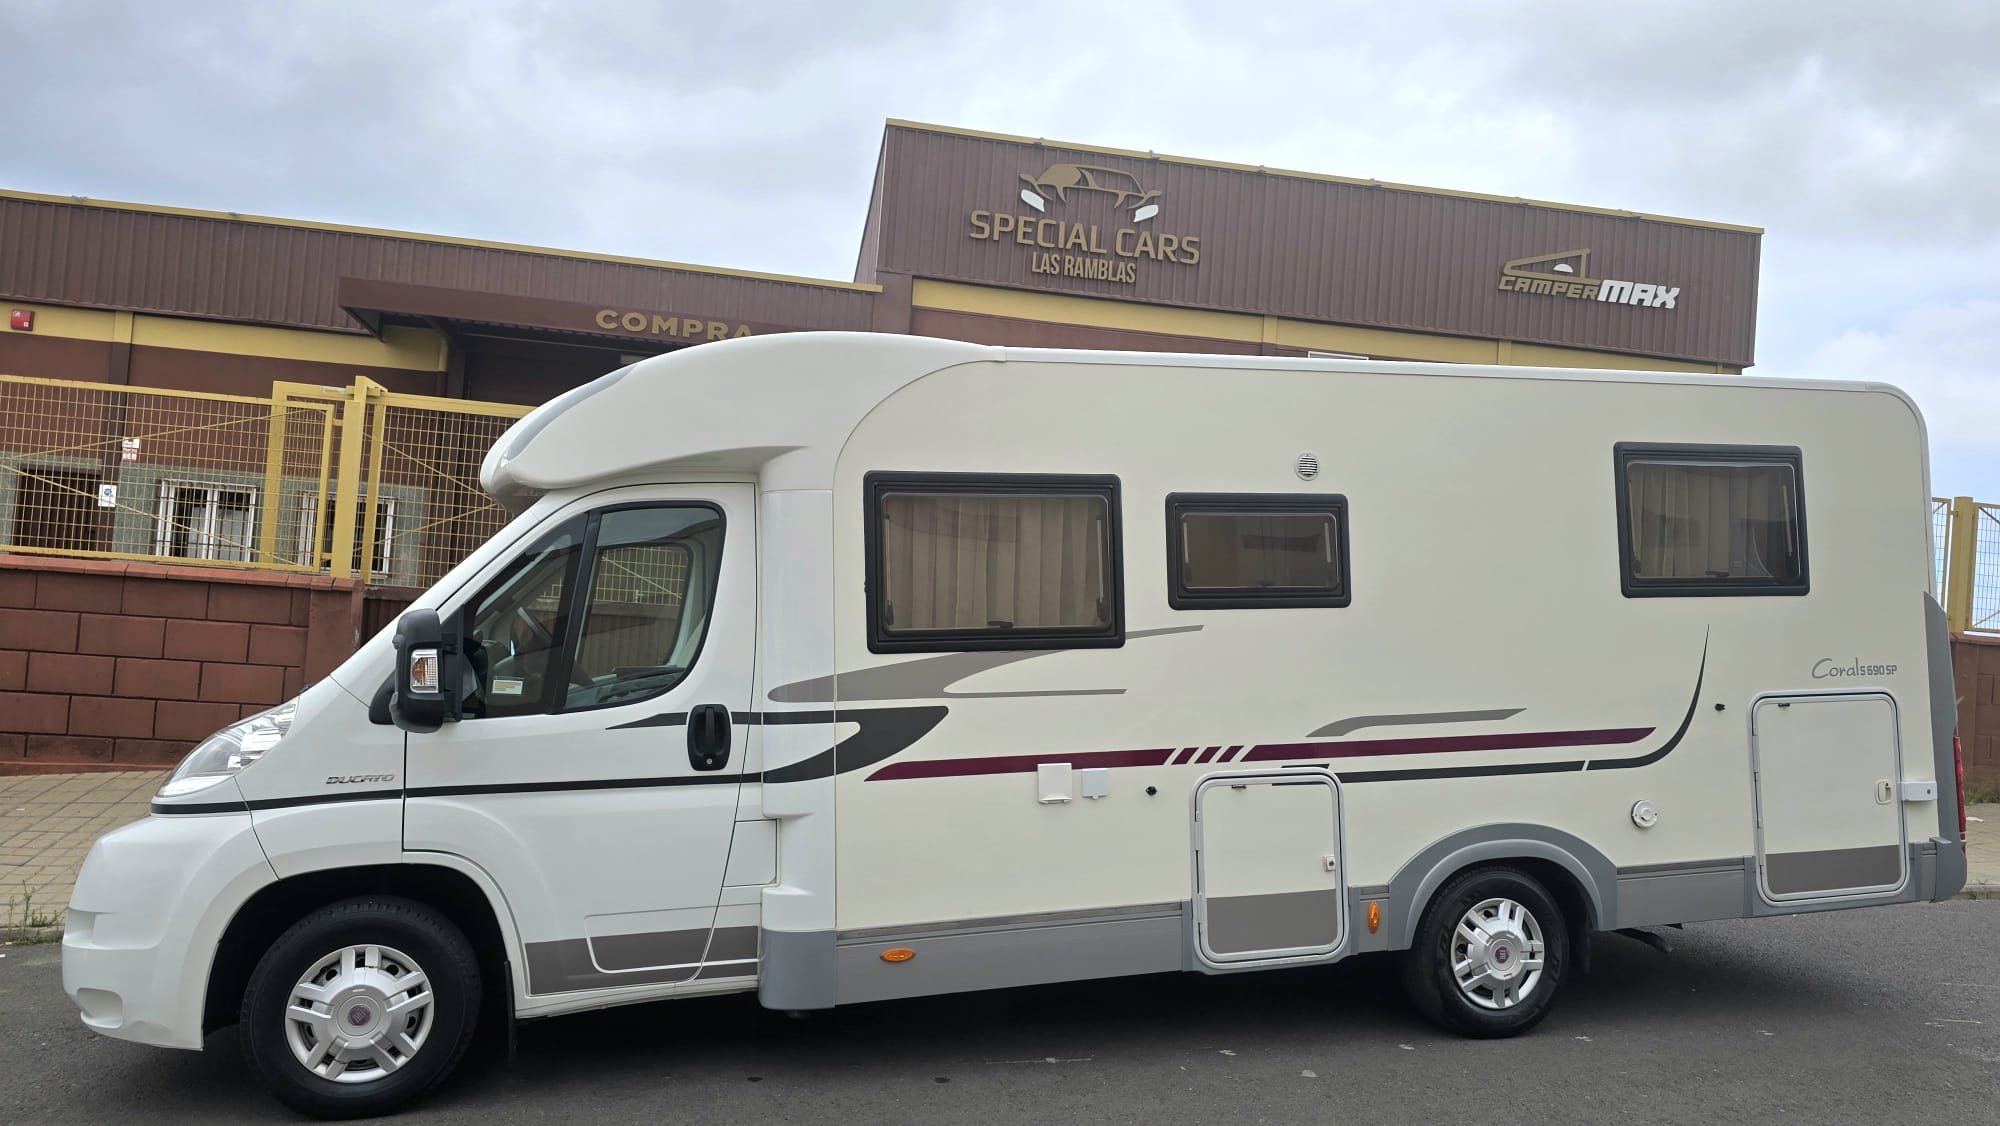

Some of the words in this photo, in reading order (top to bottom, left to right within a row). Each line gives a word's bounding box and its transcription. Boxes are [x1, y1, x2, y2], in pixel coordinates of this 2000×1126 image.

[969, 210, 1108, 254] SPECIAL
[1115, 228, 1200, 265] CARS
[1031, 251, 1060, 275] LAS
[1063, 255, 1136, 283] RAMBLAS
[595, 309, 752, 340] COMPRA
[326, 774, 395, 784] DUCATO
